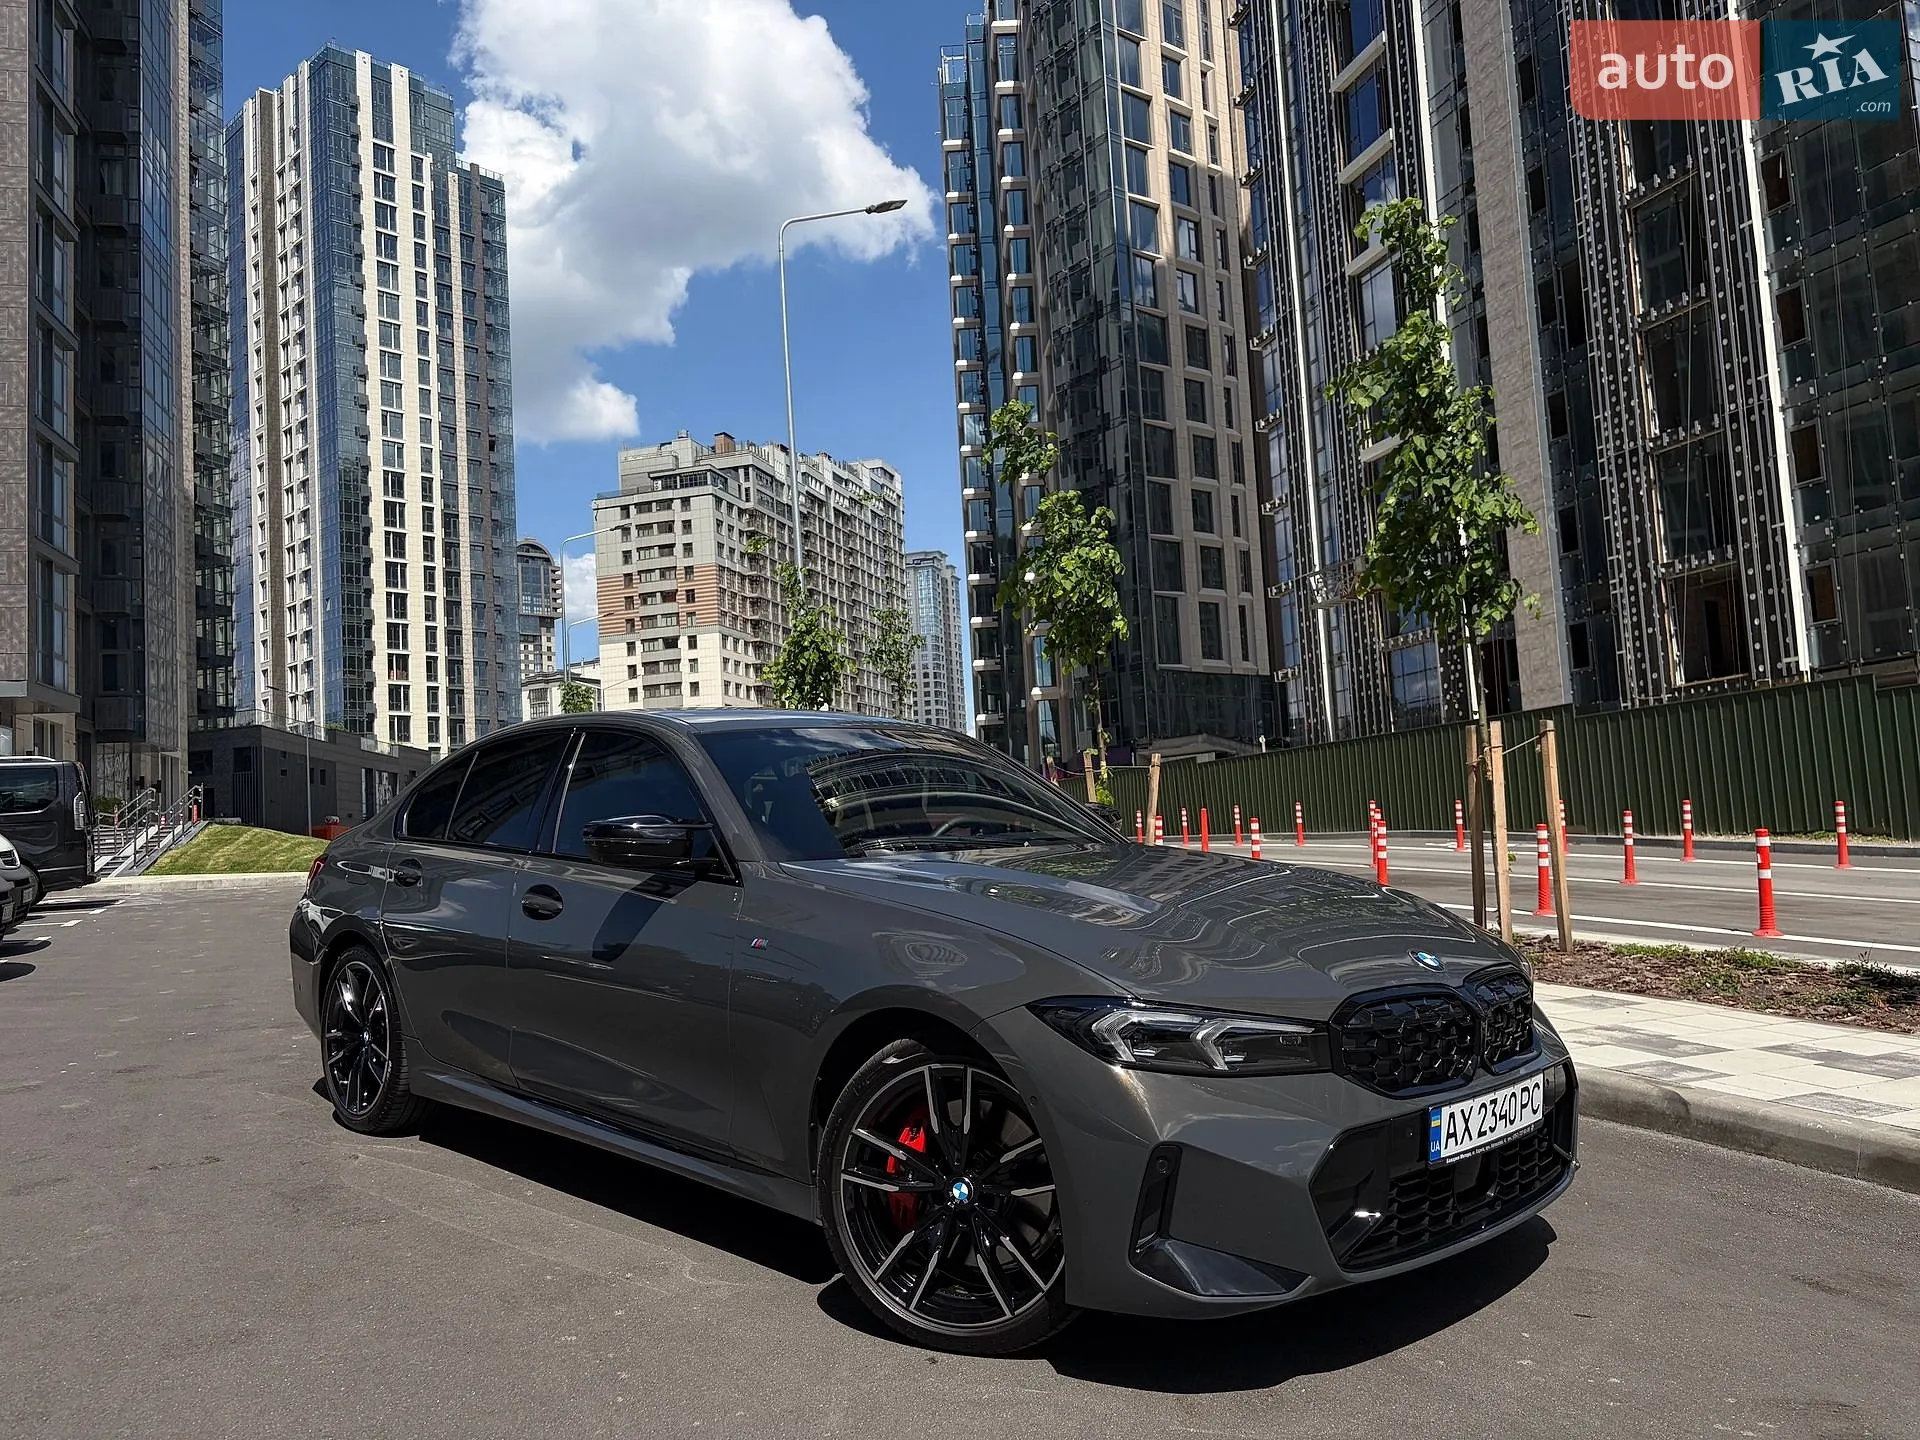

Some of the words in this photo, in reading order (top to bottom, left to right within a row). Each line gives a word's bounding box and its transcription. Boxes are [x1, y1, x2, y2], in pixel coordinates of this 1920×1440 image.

[1444, 1105, 1474, 1149] AX
[1477, 1092, 1517, 1139] 2340
[1519, 1081, 1541, 1122] PC
[1430, 1140, 1441, 1152] UA
